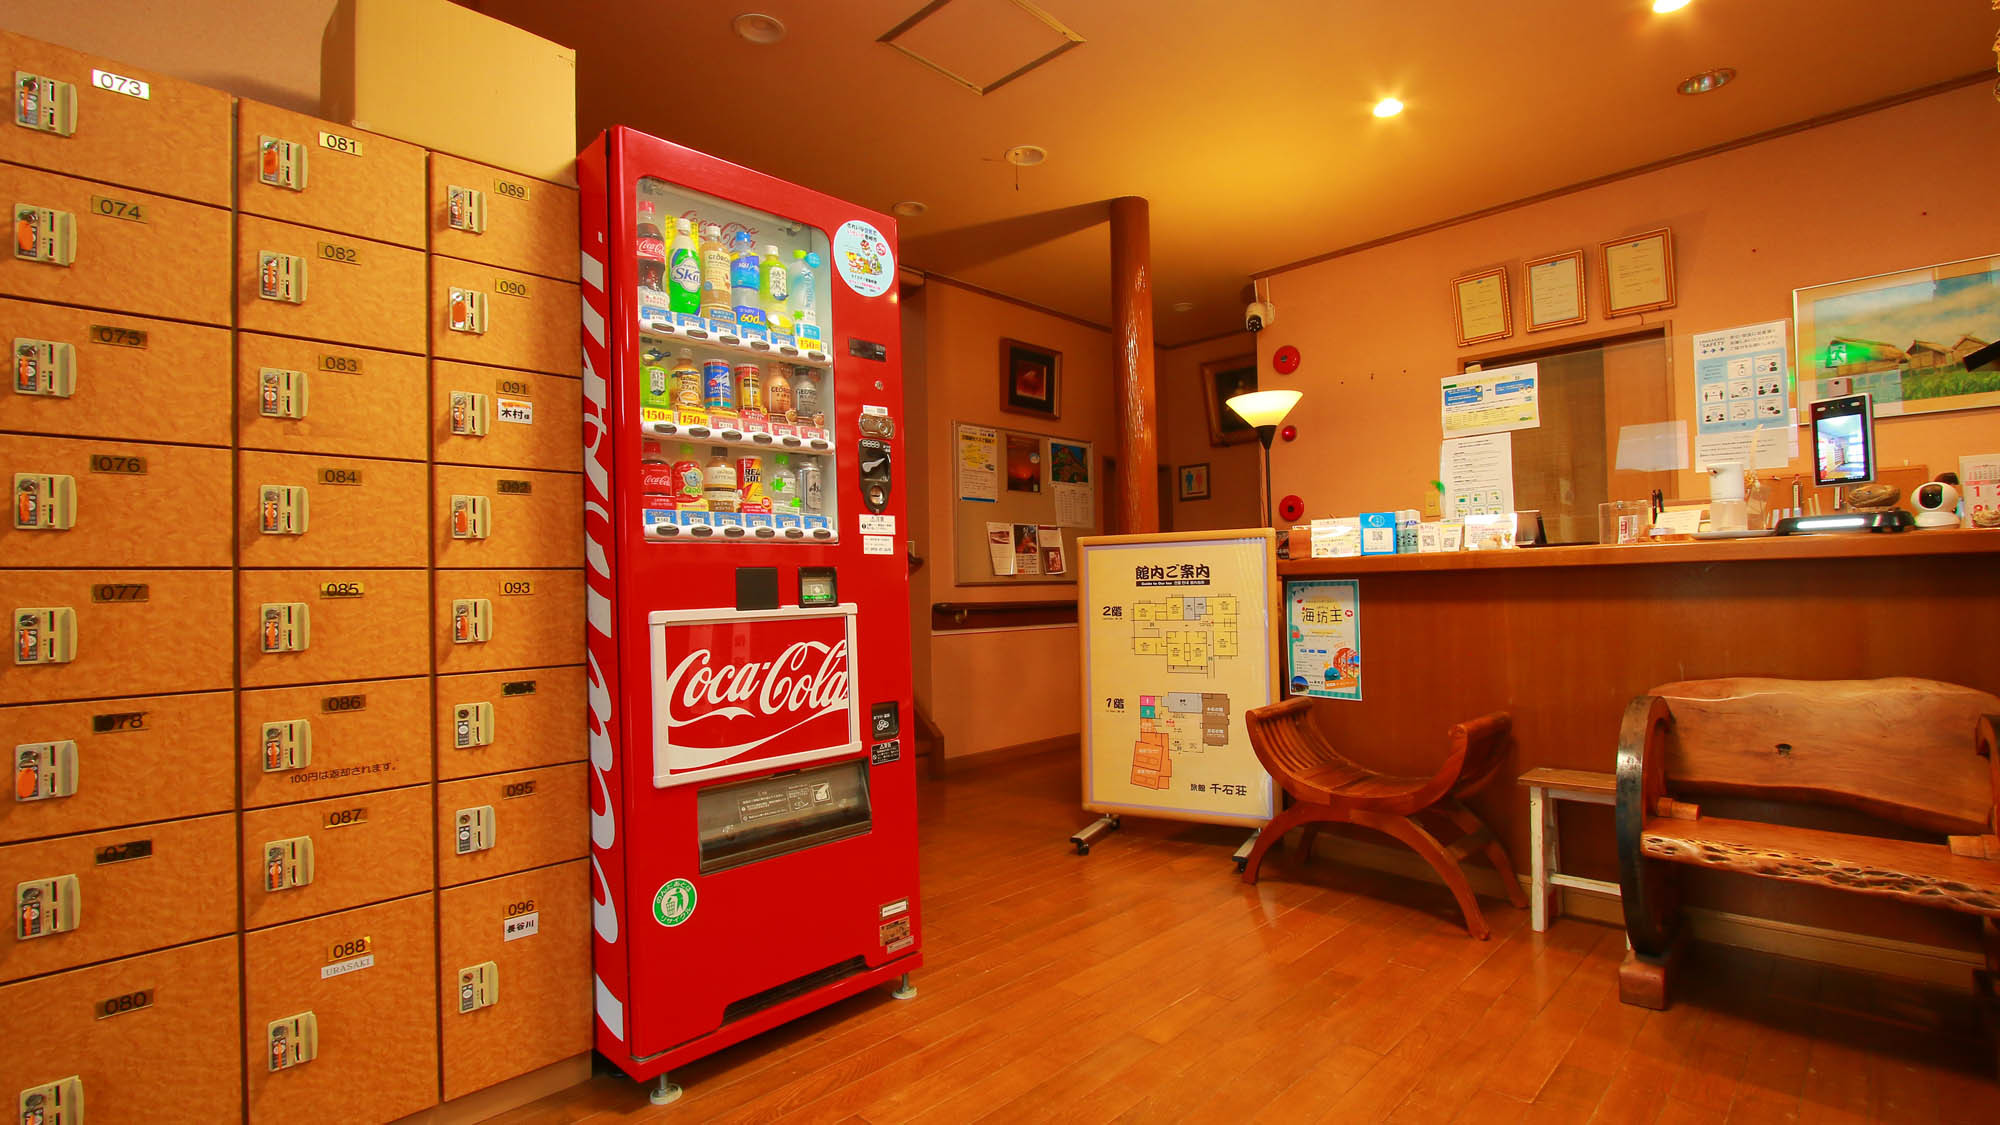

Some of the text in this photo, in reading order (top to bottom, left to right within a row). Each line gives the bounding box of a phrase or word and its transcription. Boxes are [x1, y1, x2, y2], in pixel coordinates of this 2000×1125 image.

[101, 73, 142, 96] 073
[326, 134, 357, 153] 081
[499, 181, 525, 198] 089
[100, 199, 142, 220] 074
[324, 244, 357, 263] 082
[500, 280, 526, 296] 090
[99, 328, 141, 346] 075
[325, 356, 358, 372] 083
[502, 380, 527, 395] 091
[646, 410, 673, 422] 150円
[682, 415, 708, 425] 150円
[99, 456, 140, 473] 076
[324, 469, 357, 484] 084
[1135, 563, 1210, 580] 館内ご案内
[101, 585, 142, 600] 077
[326, 583, 360, 597] 085
[504, 582, 530, 594] 093
[1102, 605, 1122, 617] 2階
[667, 640, 849, 728] Coca-Cola
[328, 696, 362, 712] 086
[1106, 697, 1125, 710] 1階
[290, 762, 397, 784] 100円は返却されます。
[506, 781, 533, 798] 095
[330, 808, 363, 826] 087
[508, 899, 535, 916] 096
[507, 919, 534, 934] 長谷川
[333, 938, 366, 959] 088
[326, 958, 371, 977] URASAKI
[104, 991, 147, 1015] 080
